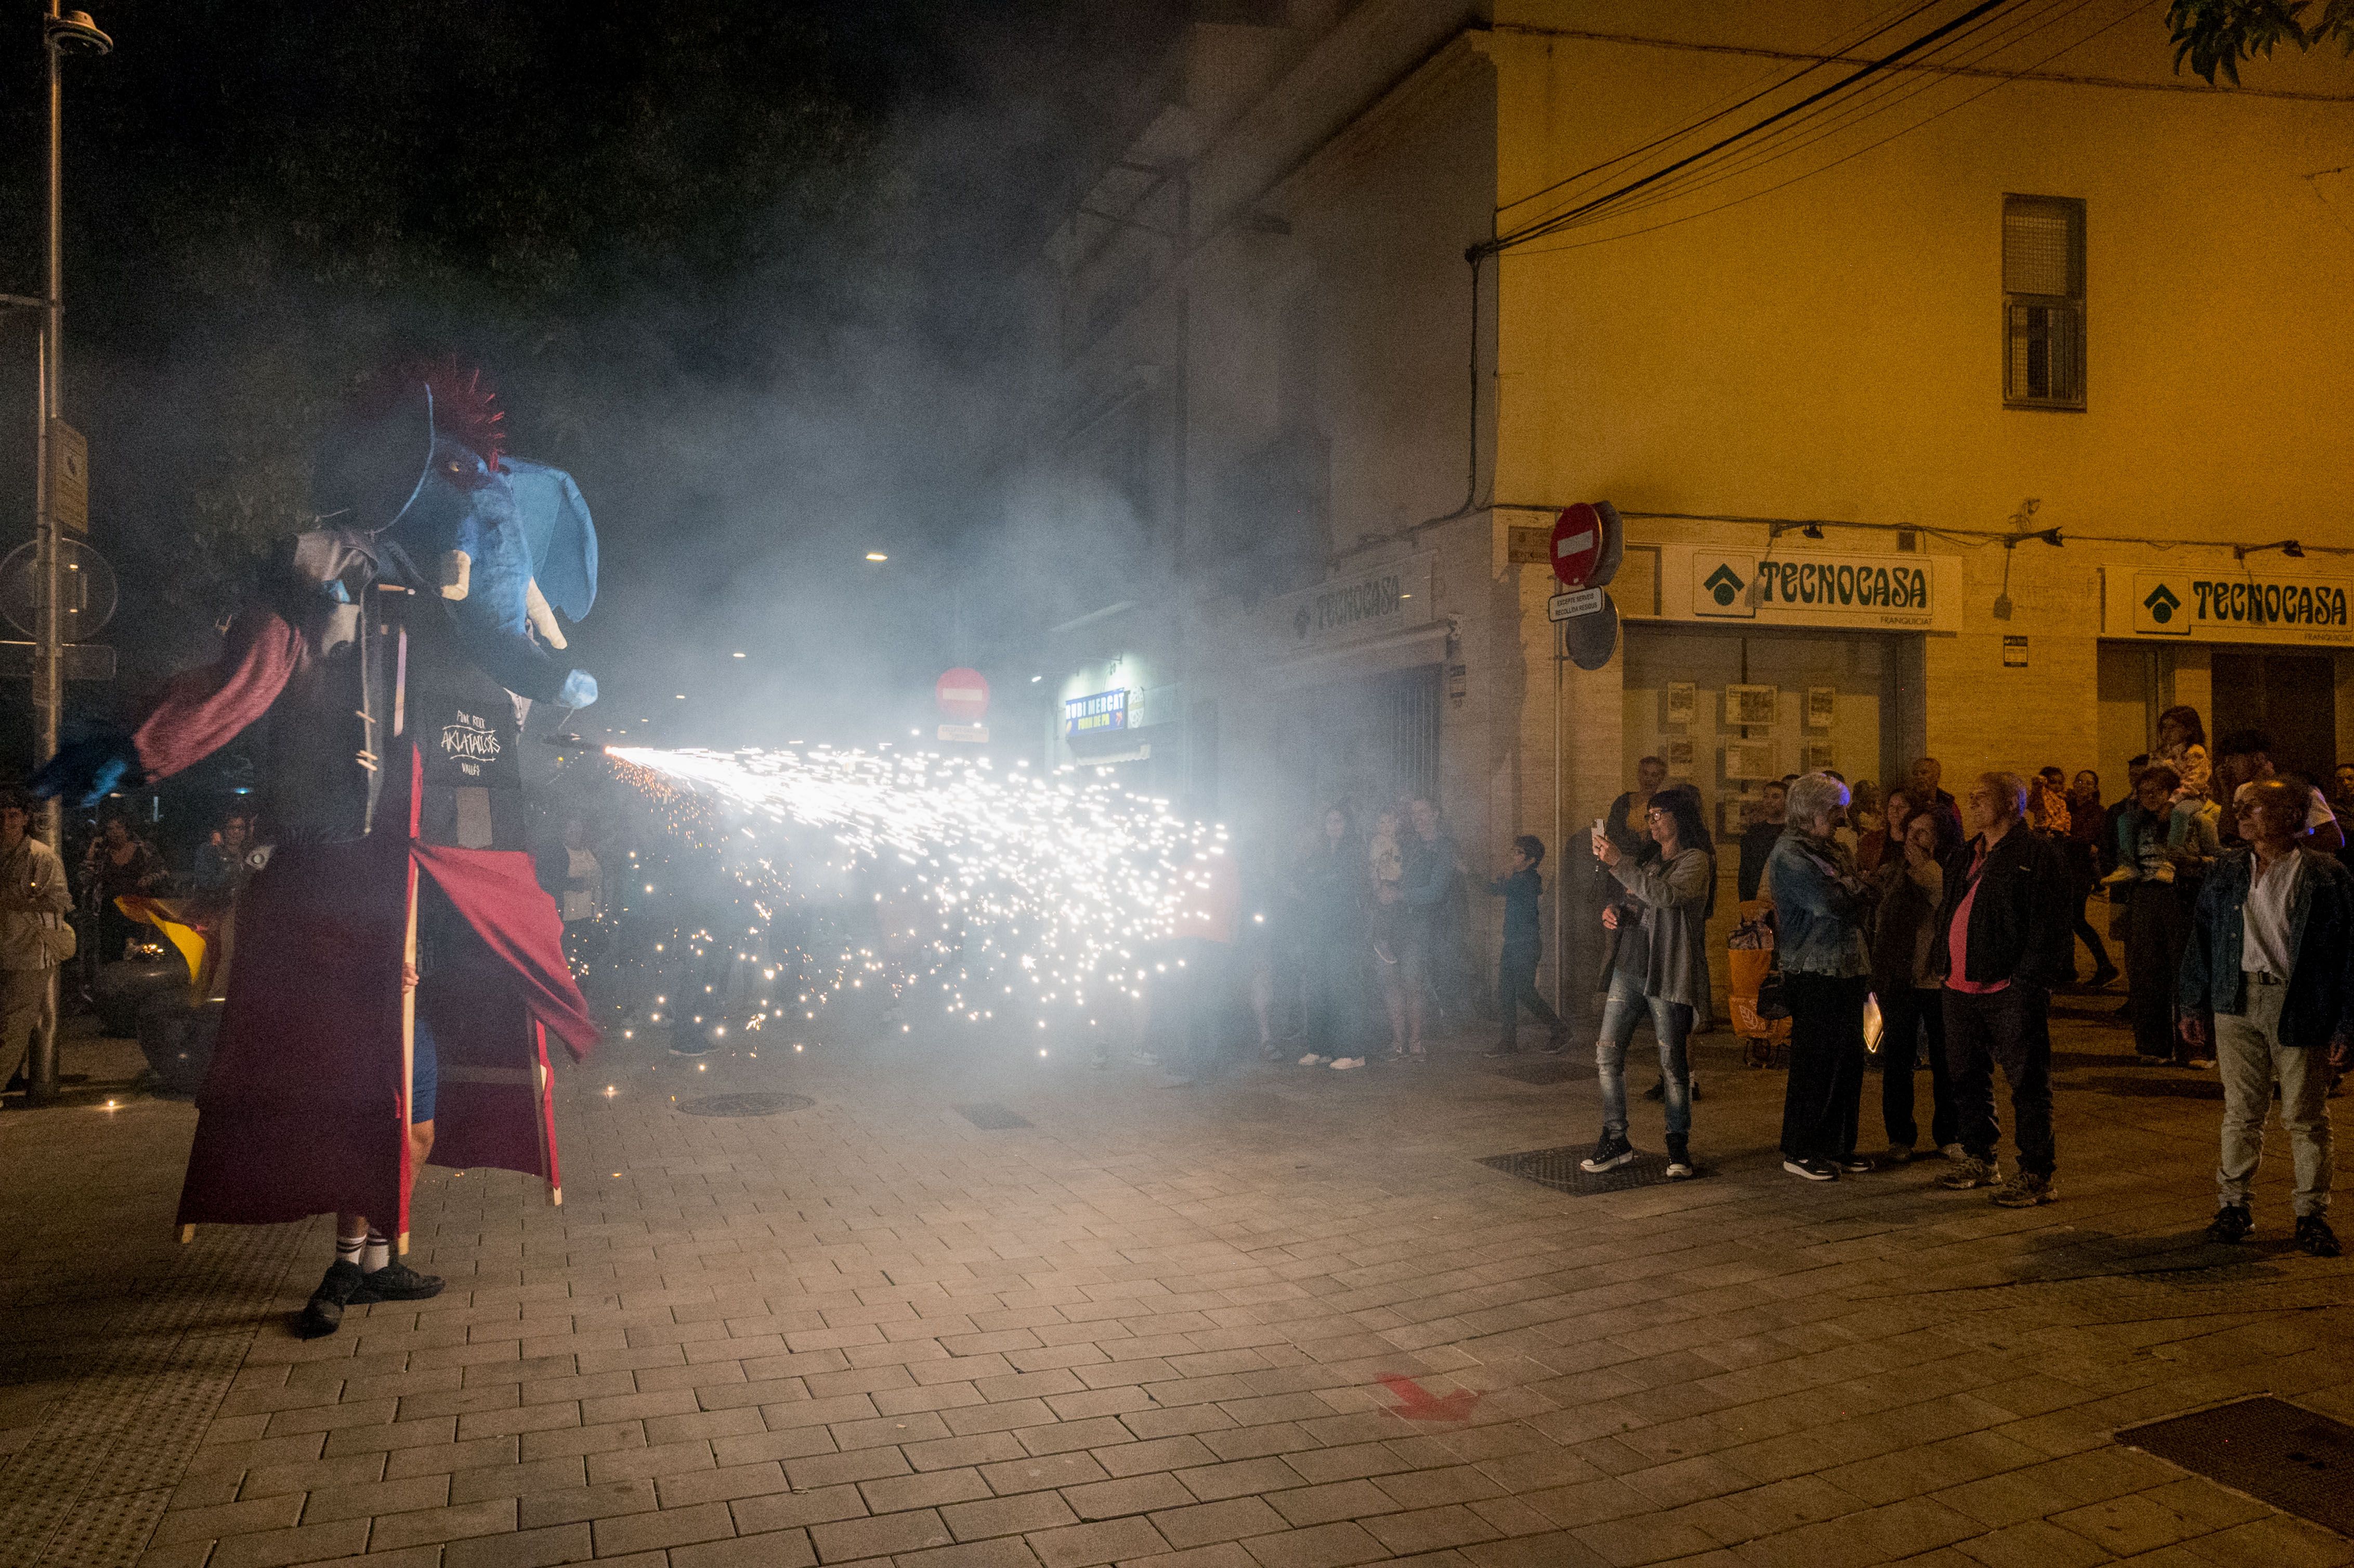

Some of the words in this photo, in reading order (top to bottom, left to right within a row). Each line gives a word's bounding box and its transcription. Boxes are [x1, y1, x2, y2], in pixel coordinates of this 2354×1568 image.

[1759, 561, 1927, 608] TECNOCASA
[1317, 574, 1399, 630] TECNOCASA
[1557, 597, 1575, 606] EXCEPTE
[1576, 593, 1594, 602] SERVEIS
[2193, 581, 2346, 625] TECNOCASA
[1555, 607, 1578, 616] RECOLLIDA
[1579, 602, 1597, 611] RESIDUS
[1880, 616, 1932, 625] FRANQUICIAT
[1088, 692, 1124, 715] MERCAT
[473, 715, 486, 729] ROCK
[1094, 715, 1101, 728] DE
[1102, 713, 1110, 727] PA
